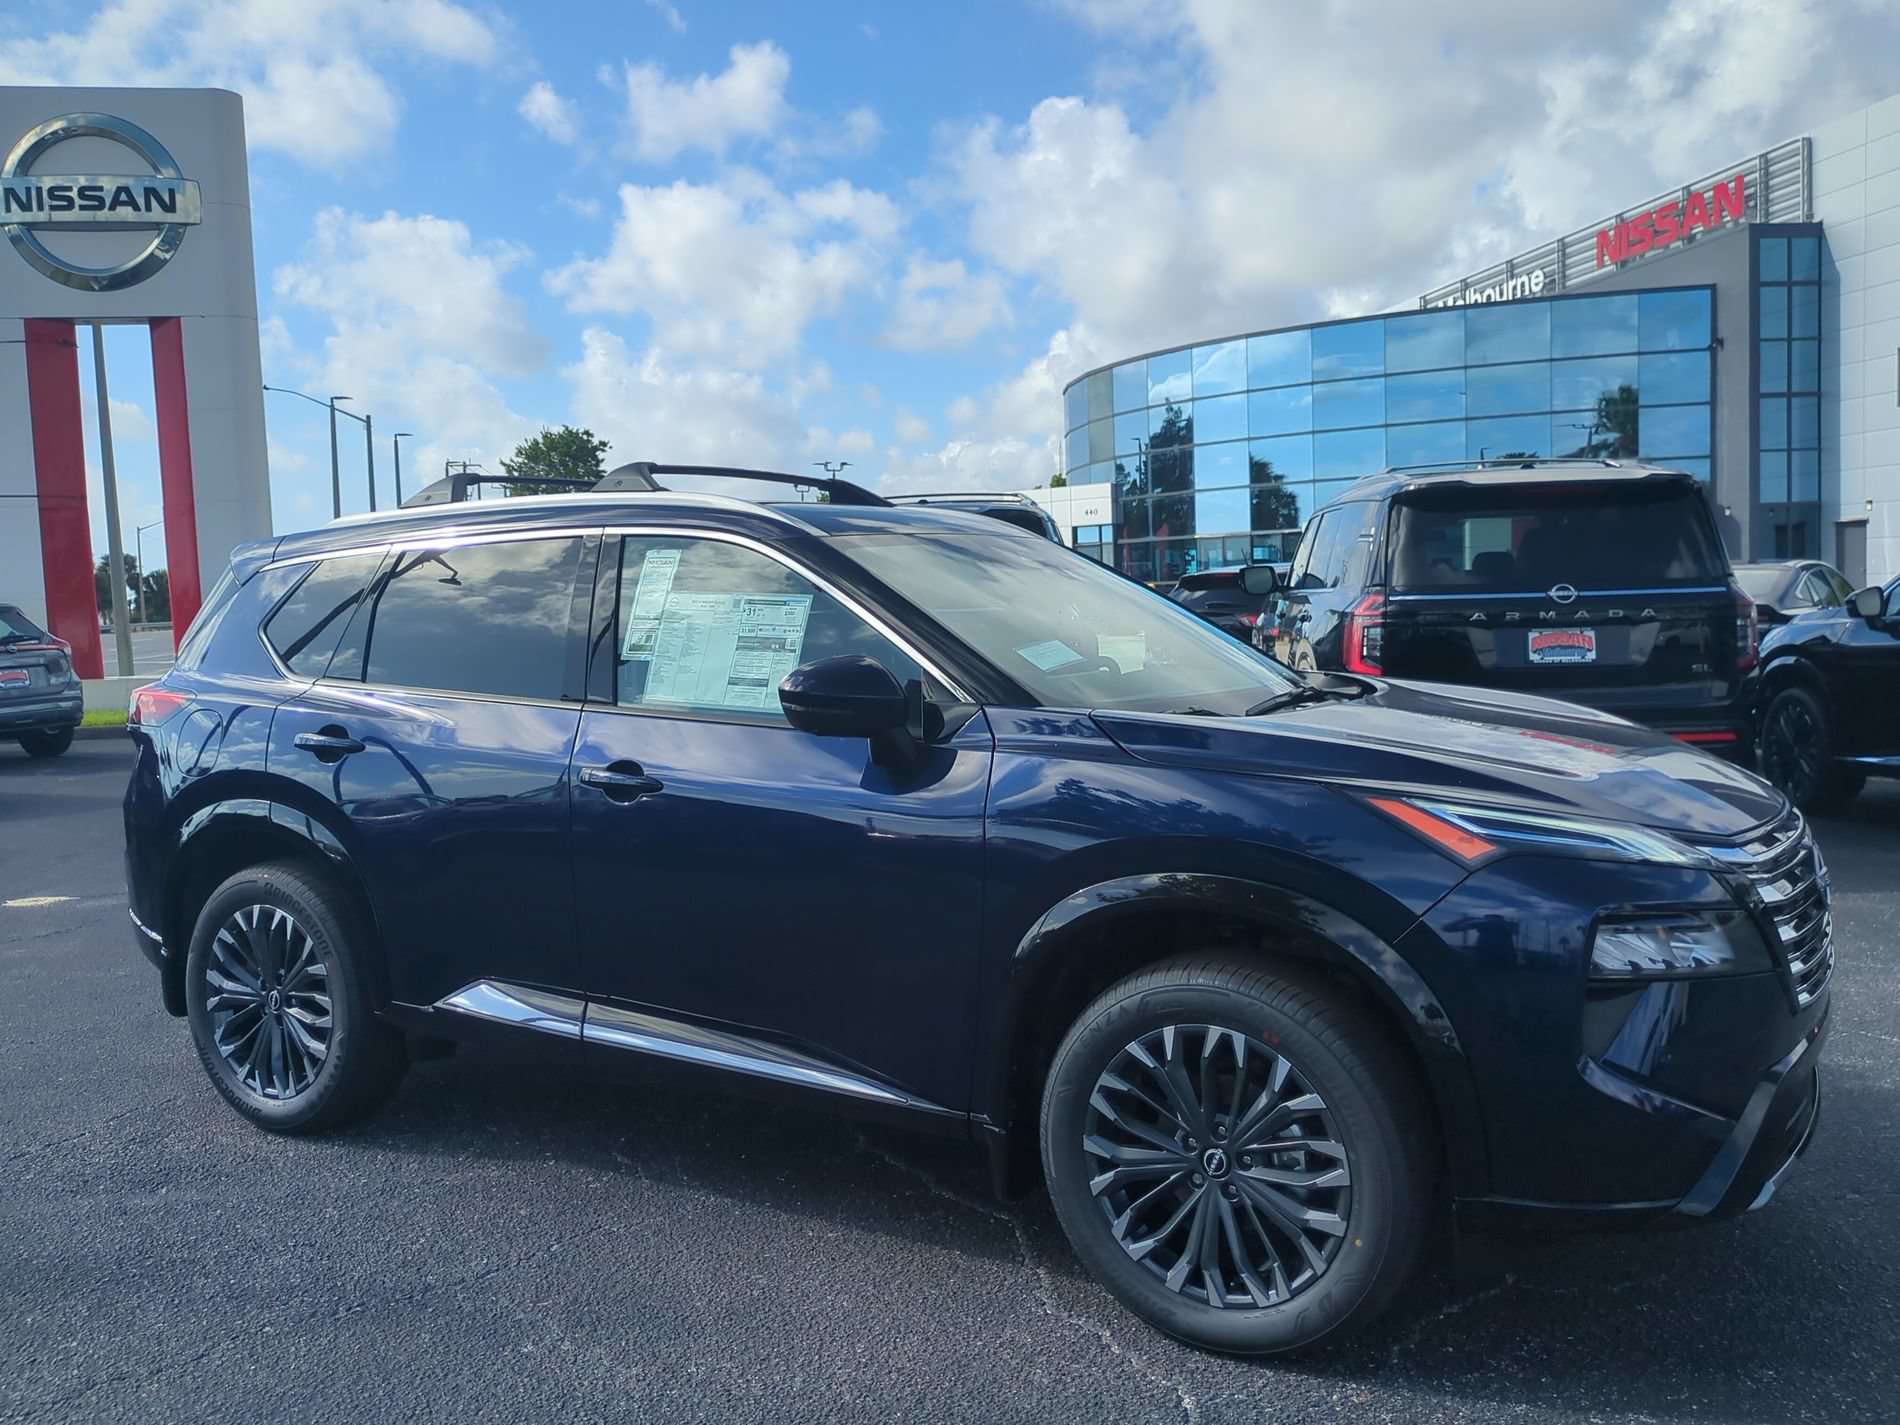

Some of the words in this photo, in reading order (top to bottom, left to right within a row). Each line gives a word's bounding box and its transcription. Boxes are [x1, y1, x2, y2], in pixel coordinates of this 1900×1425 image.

[4, 185, 177, 214] NISSAN
[1596, 174, 1745, 268] NISSAN
[1438, 269, 1544, 307] lbourne
[1085, 508, 1098, 516] 440
[746, 607, 757, 616] 31
[1470, 607, 1656, 621] ARMADA
[1691, 664, 1713, 673] SL
[263, 881, 335, 959] BRIDGESTONE
